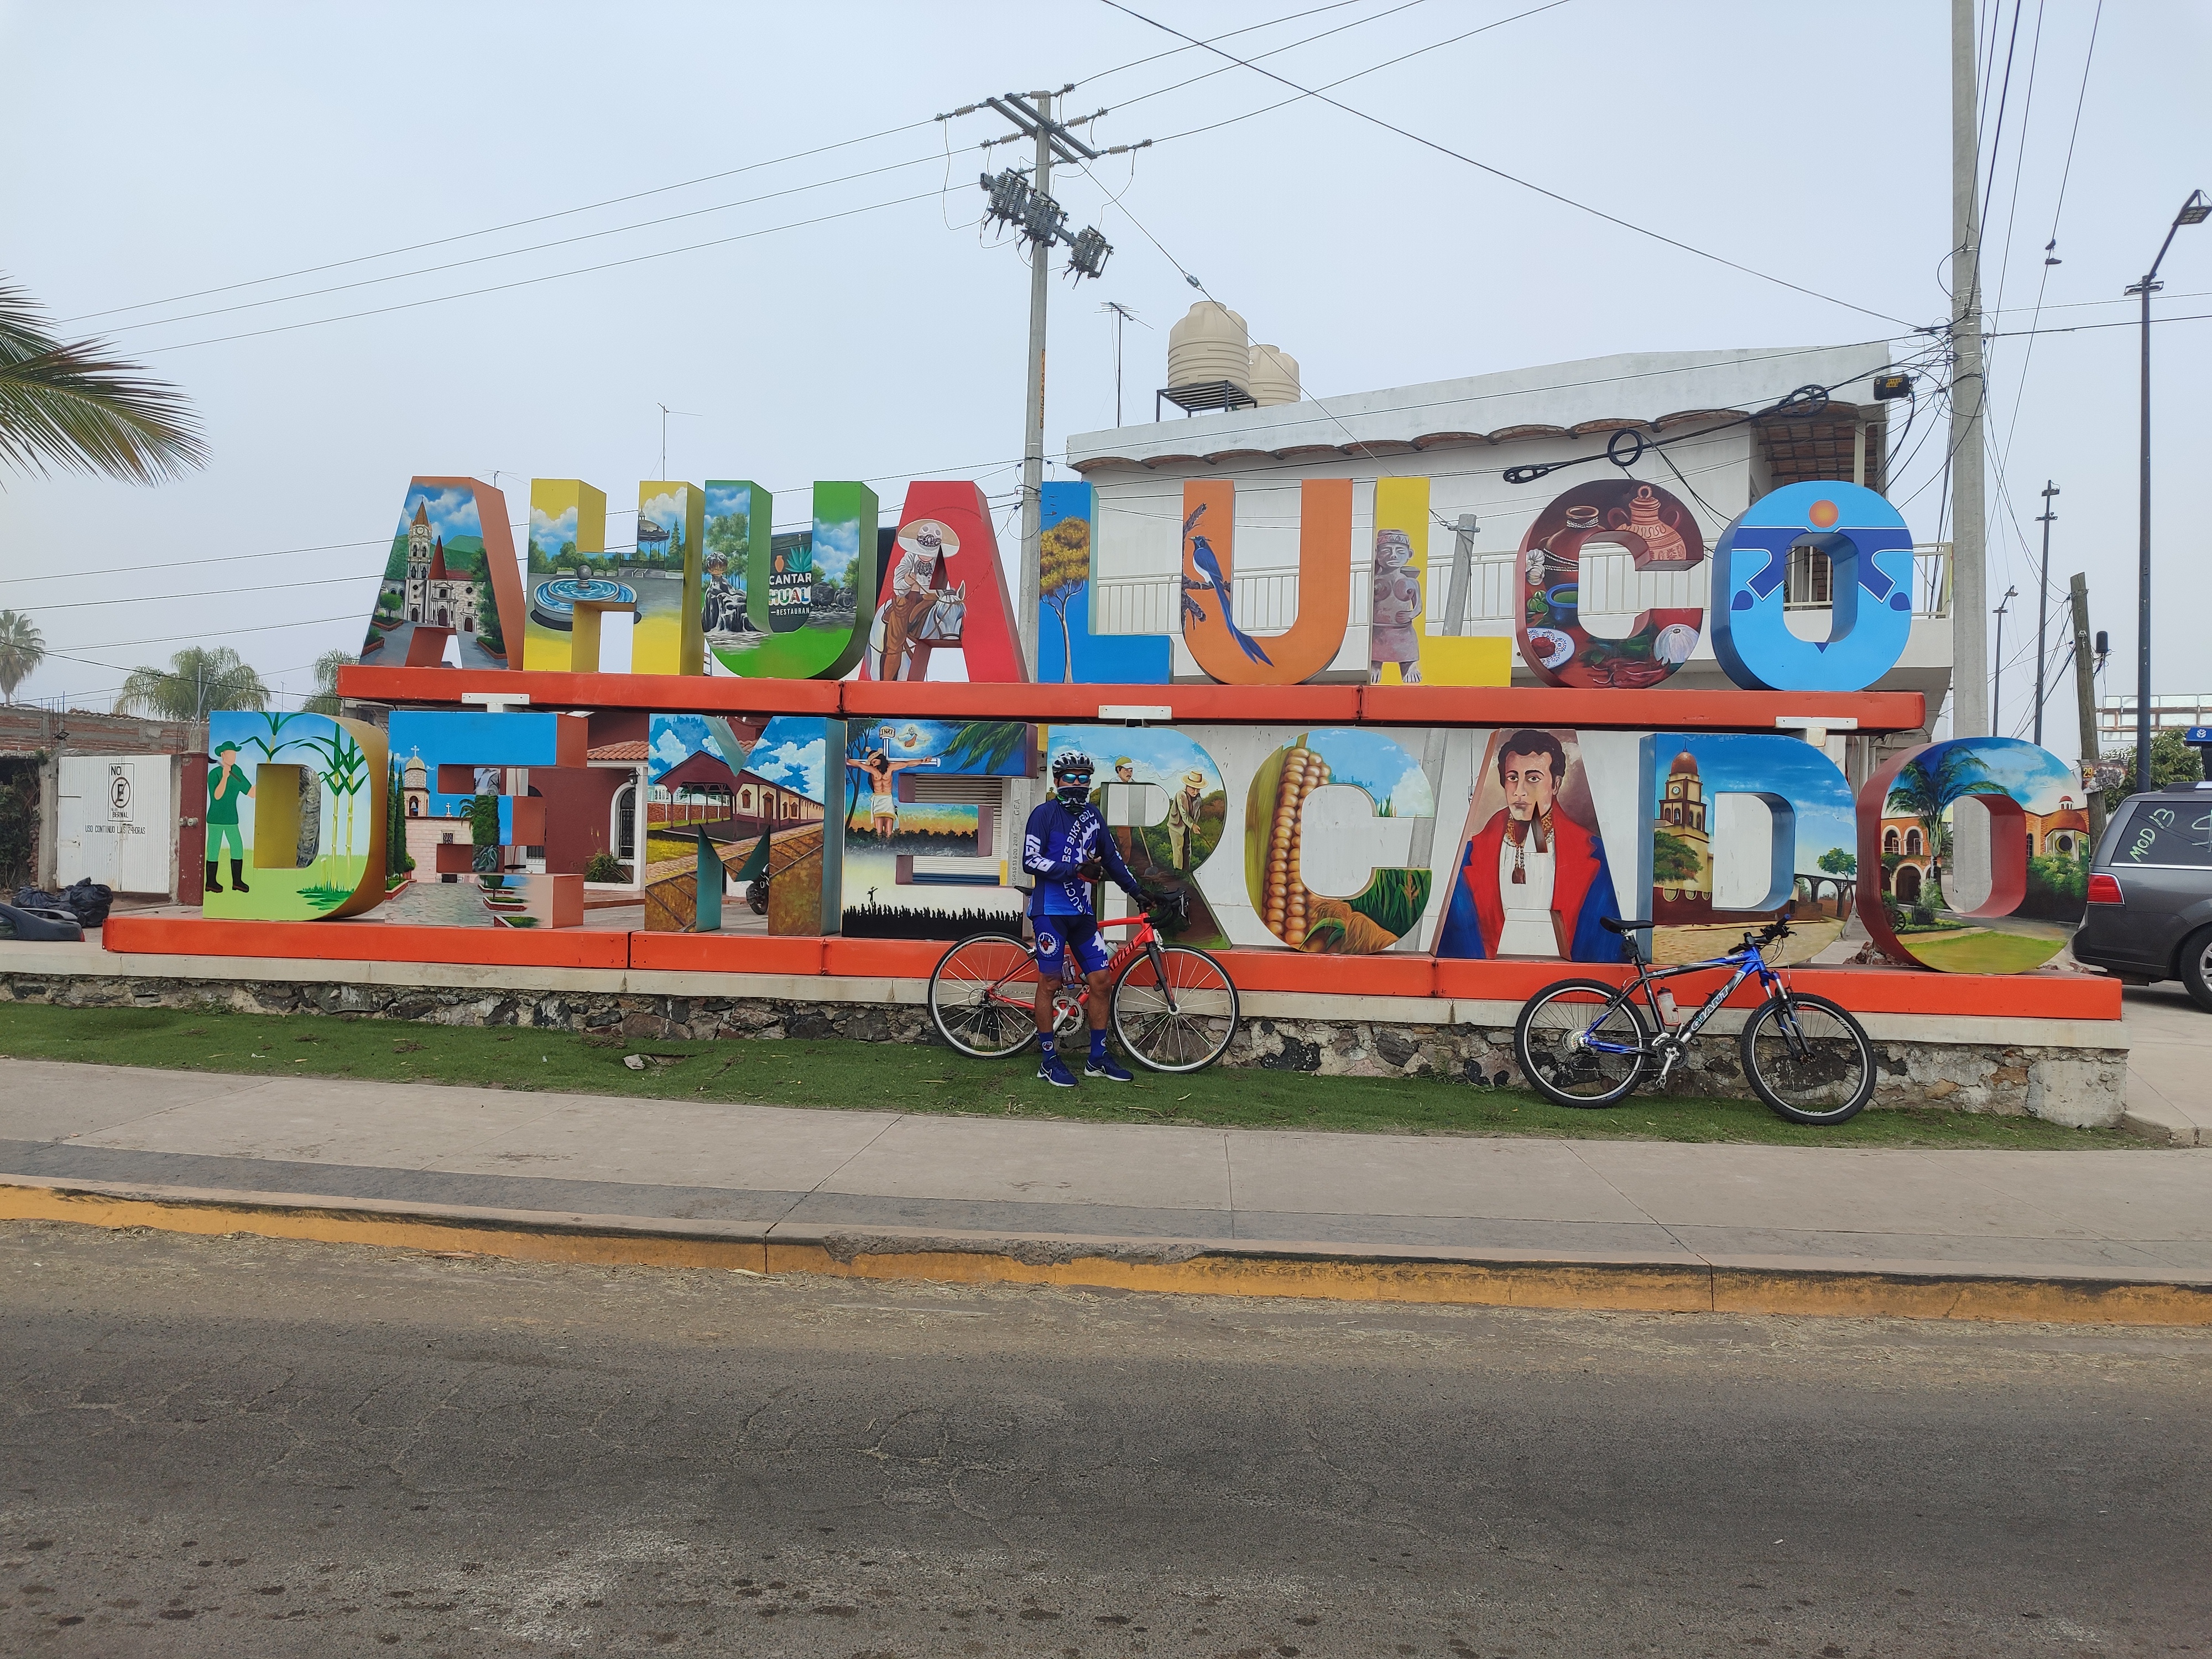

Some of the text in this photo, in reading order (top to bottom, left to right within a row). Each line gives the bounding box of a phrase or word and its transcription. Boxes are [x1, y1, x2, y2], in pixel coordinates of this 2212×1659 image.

[359, 475, 1913, 691] AHUALULCO
[769, 572, 811, 585] CANTAR
[111, 765, 122, 776] NO
[2083, 767, 2093, 778] 29
[117, 784, 124, 802] E
[1078, 810, 1095, 823] GDL
[95, 825, 115, 833] CONTINUO
[644, 712, 2090, 975] MERCADO
[2130, 828, 2156, 863] MOD
[1691, 985, 1729, 1031] GIANT
